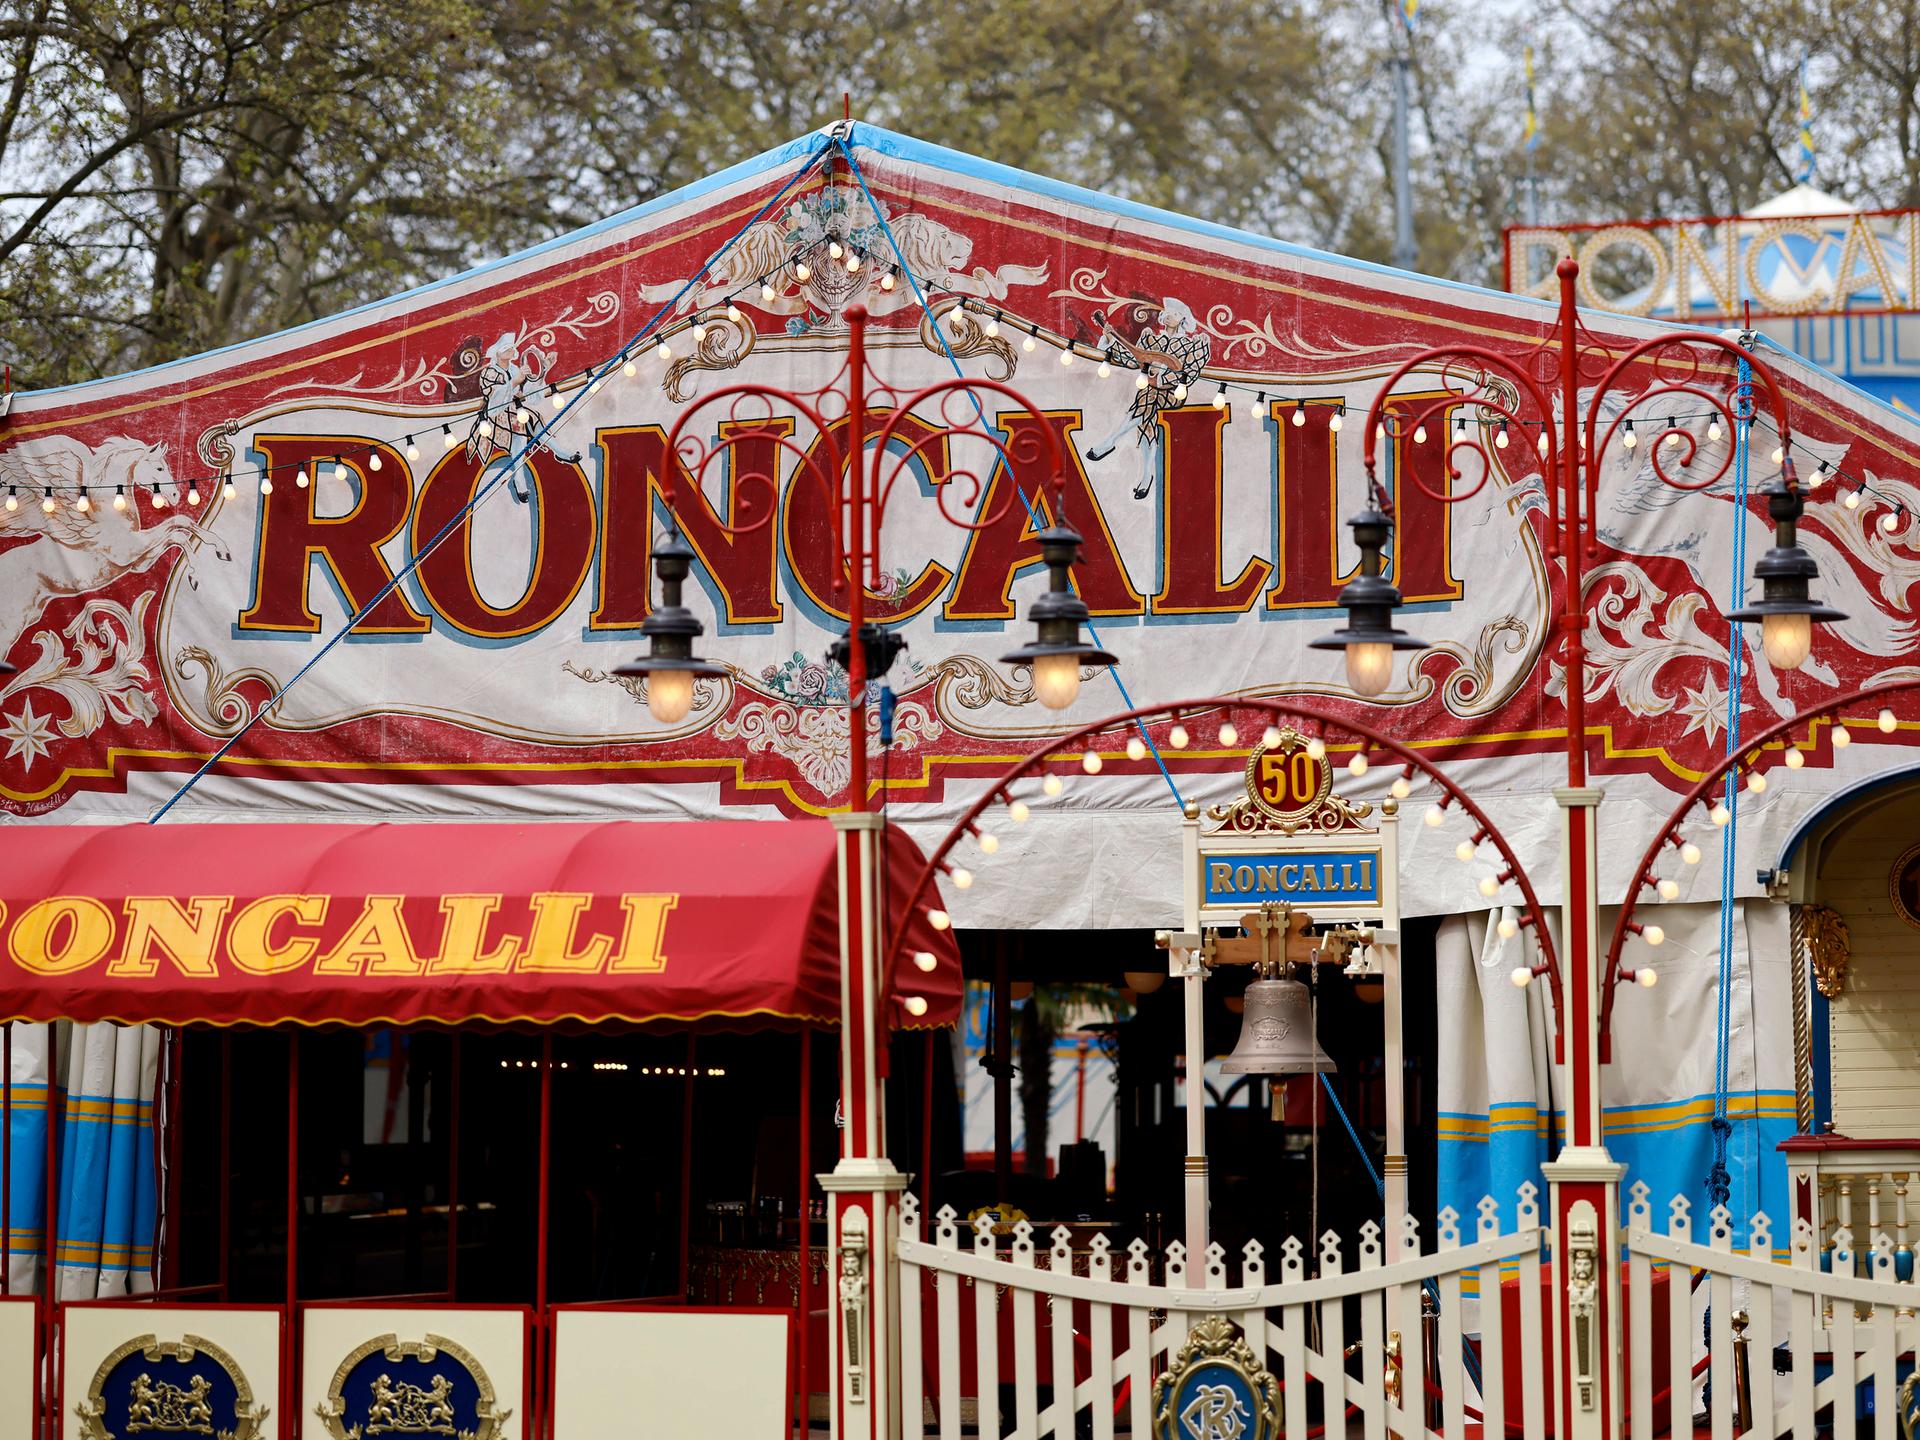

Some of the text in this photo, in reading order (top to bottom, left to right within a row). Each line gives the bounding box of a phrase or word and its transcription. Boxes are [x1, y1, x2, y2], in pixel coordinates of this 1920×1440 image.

[901, 276, 953, 304] 176
[1510, 211, 1920, 321] RONCA
[234, 389, 1466, 643] RONCALLI
[1262, 751, 1315, 804] 50
[1210, 859, 1373, 893] RONCALLI
[0, 892, 680, 978] ONCALLI
